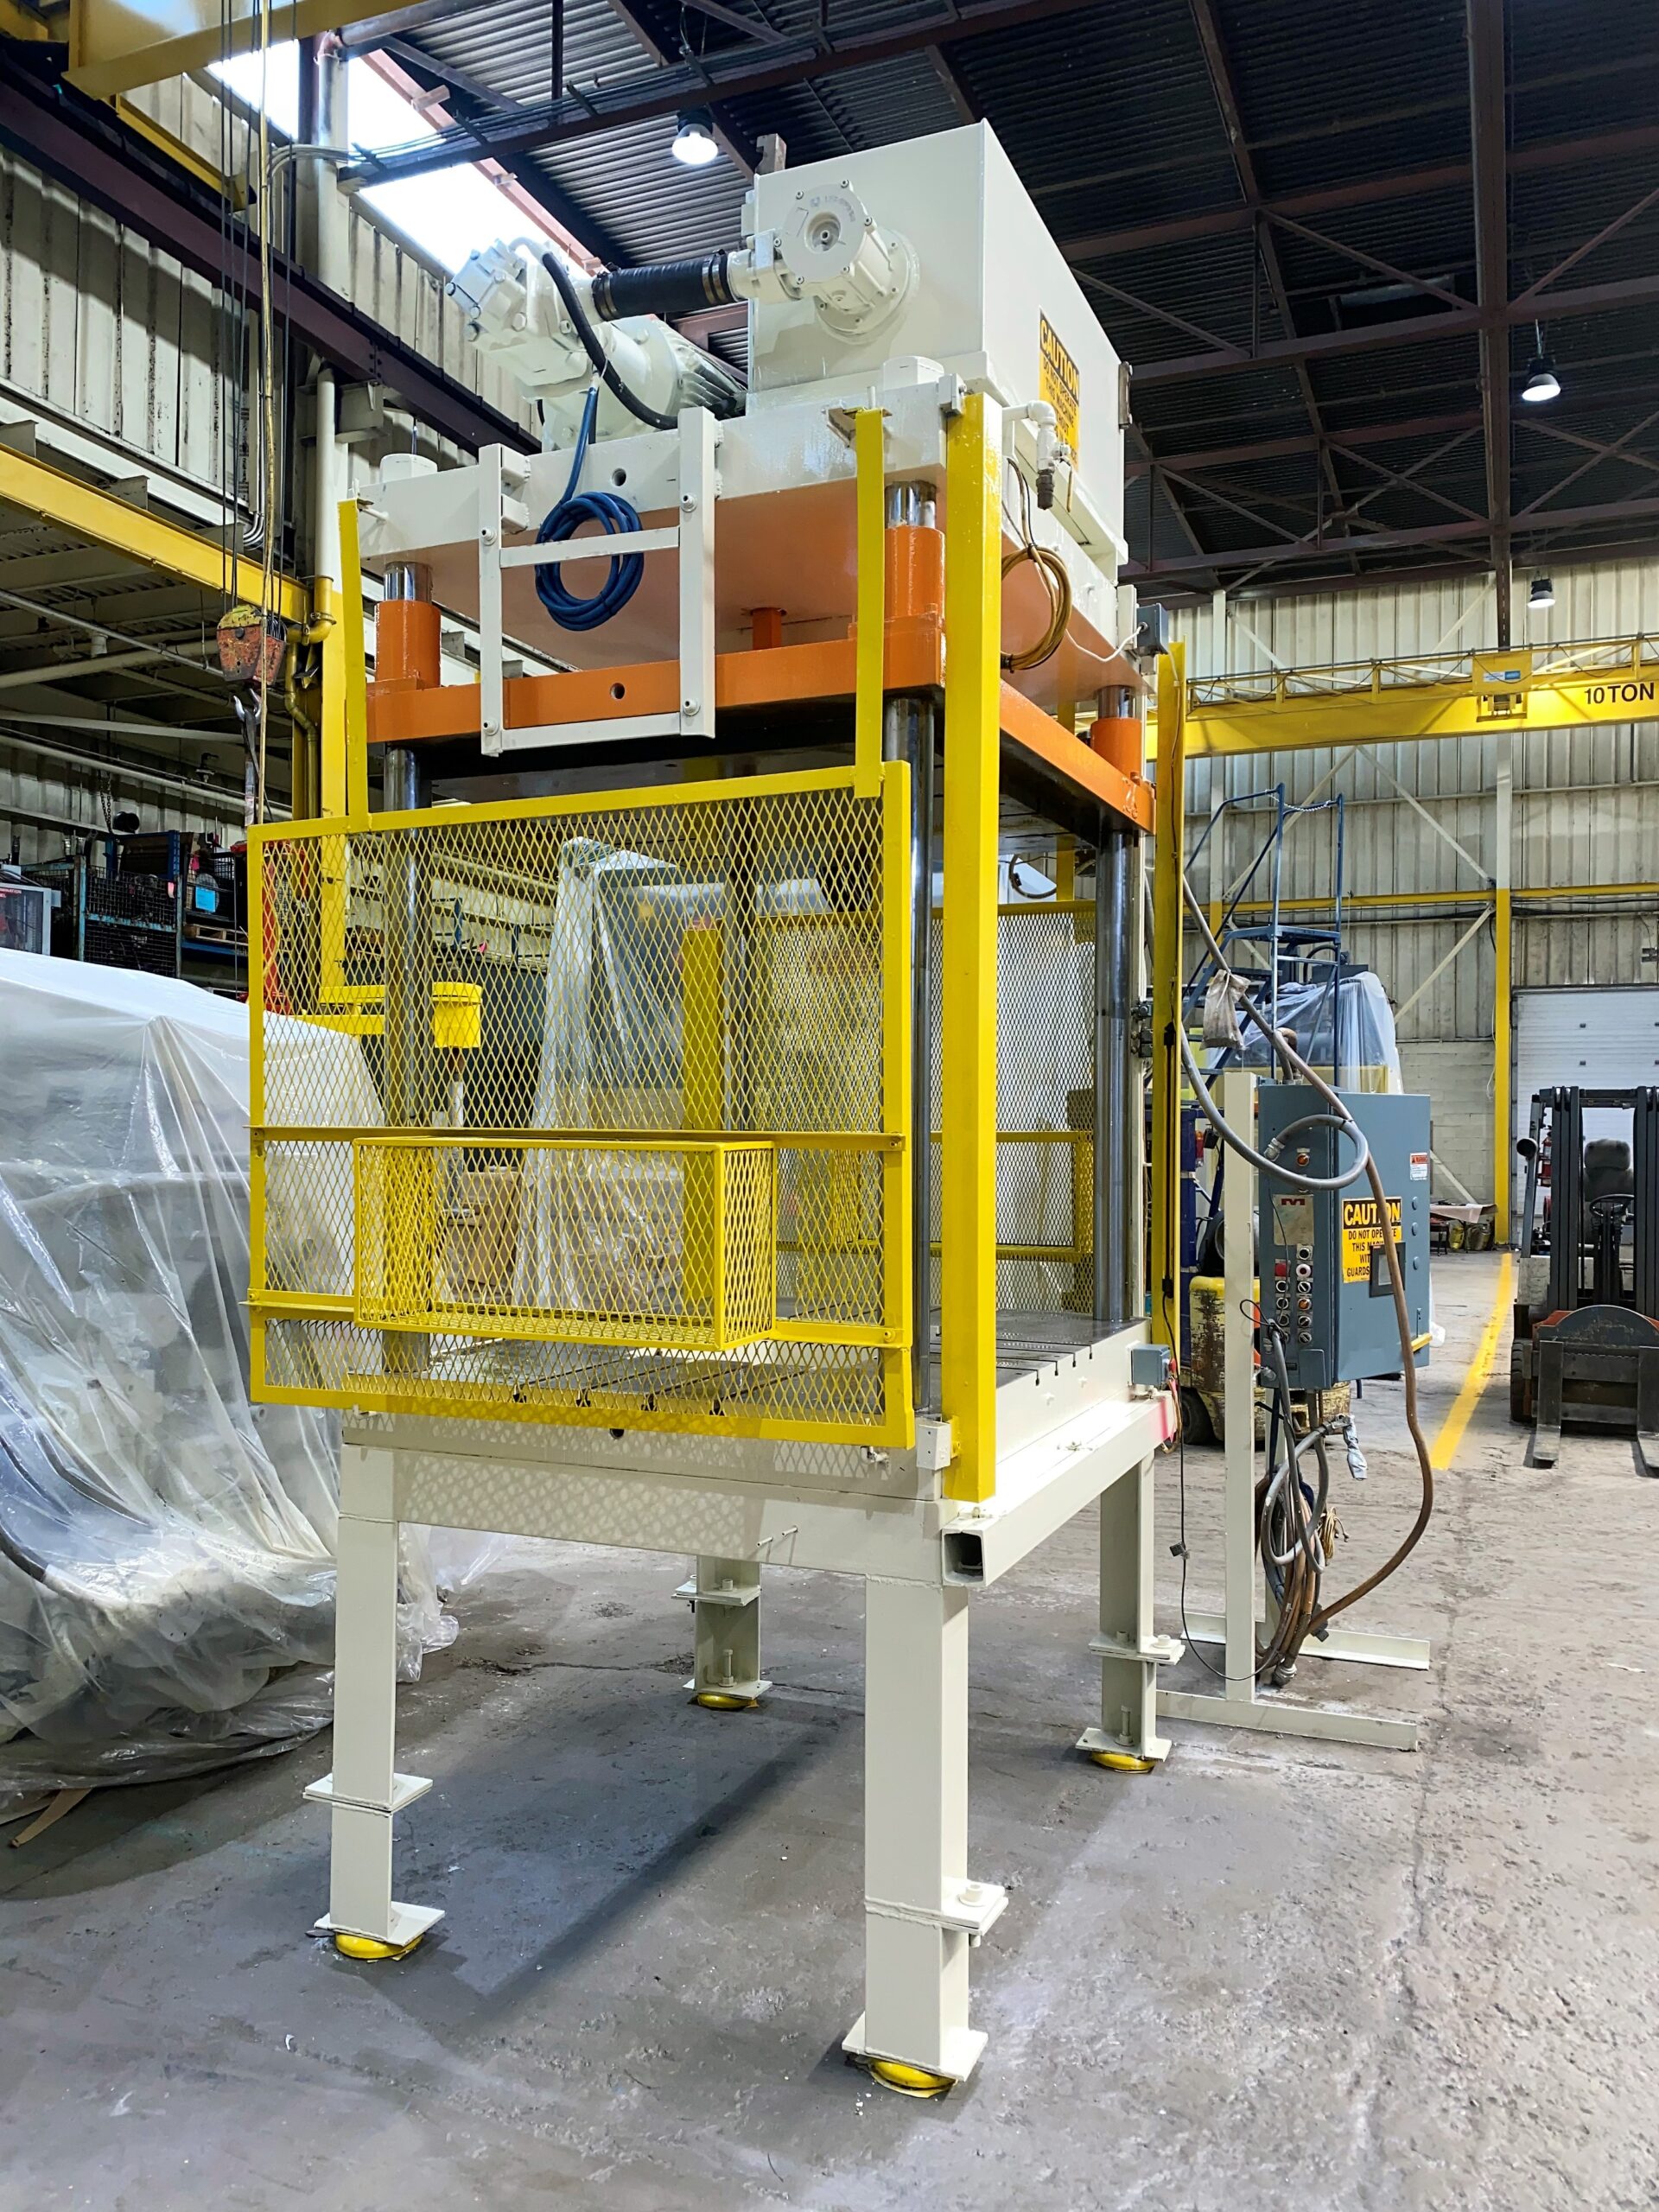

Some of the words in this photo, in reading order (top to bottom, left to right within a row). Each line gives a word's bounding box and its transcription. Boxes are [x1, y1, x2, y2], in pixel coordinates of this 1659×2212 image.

[1040, 318, 1079, 401] CAUTION
[1043, 355, 1049, 375] DO
[1058, 380, 1076, 416] OPERATE
[1585, 687, 1605, 704] 10
[1607, 683, 1655, 703] TON
[1344, 1202, 1401, 1226] CAUTN
[1348, 1230, 1357, 1240] DO
[1358, 1229, 1370, 1239] NOT
[1371, 1228, 1396, 1238] OPEE
[1352, 1242, 1365, 1252] THIS
[1346, 1266, 1370, 1277] GUARDS
